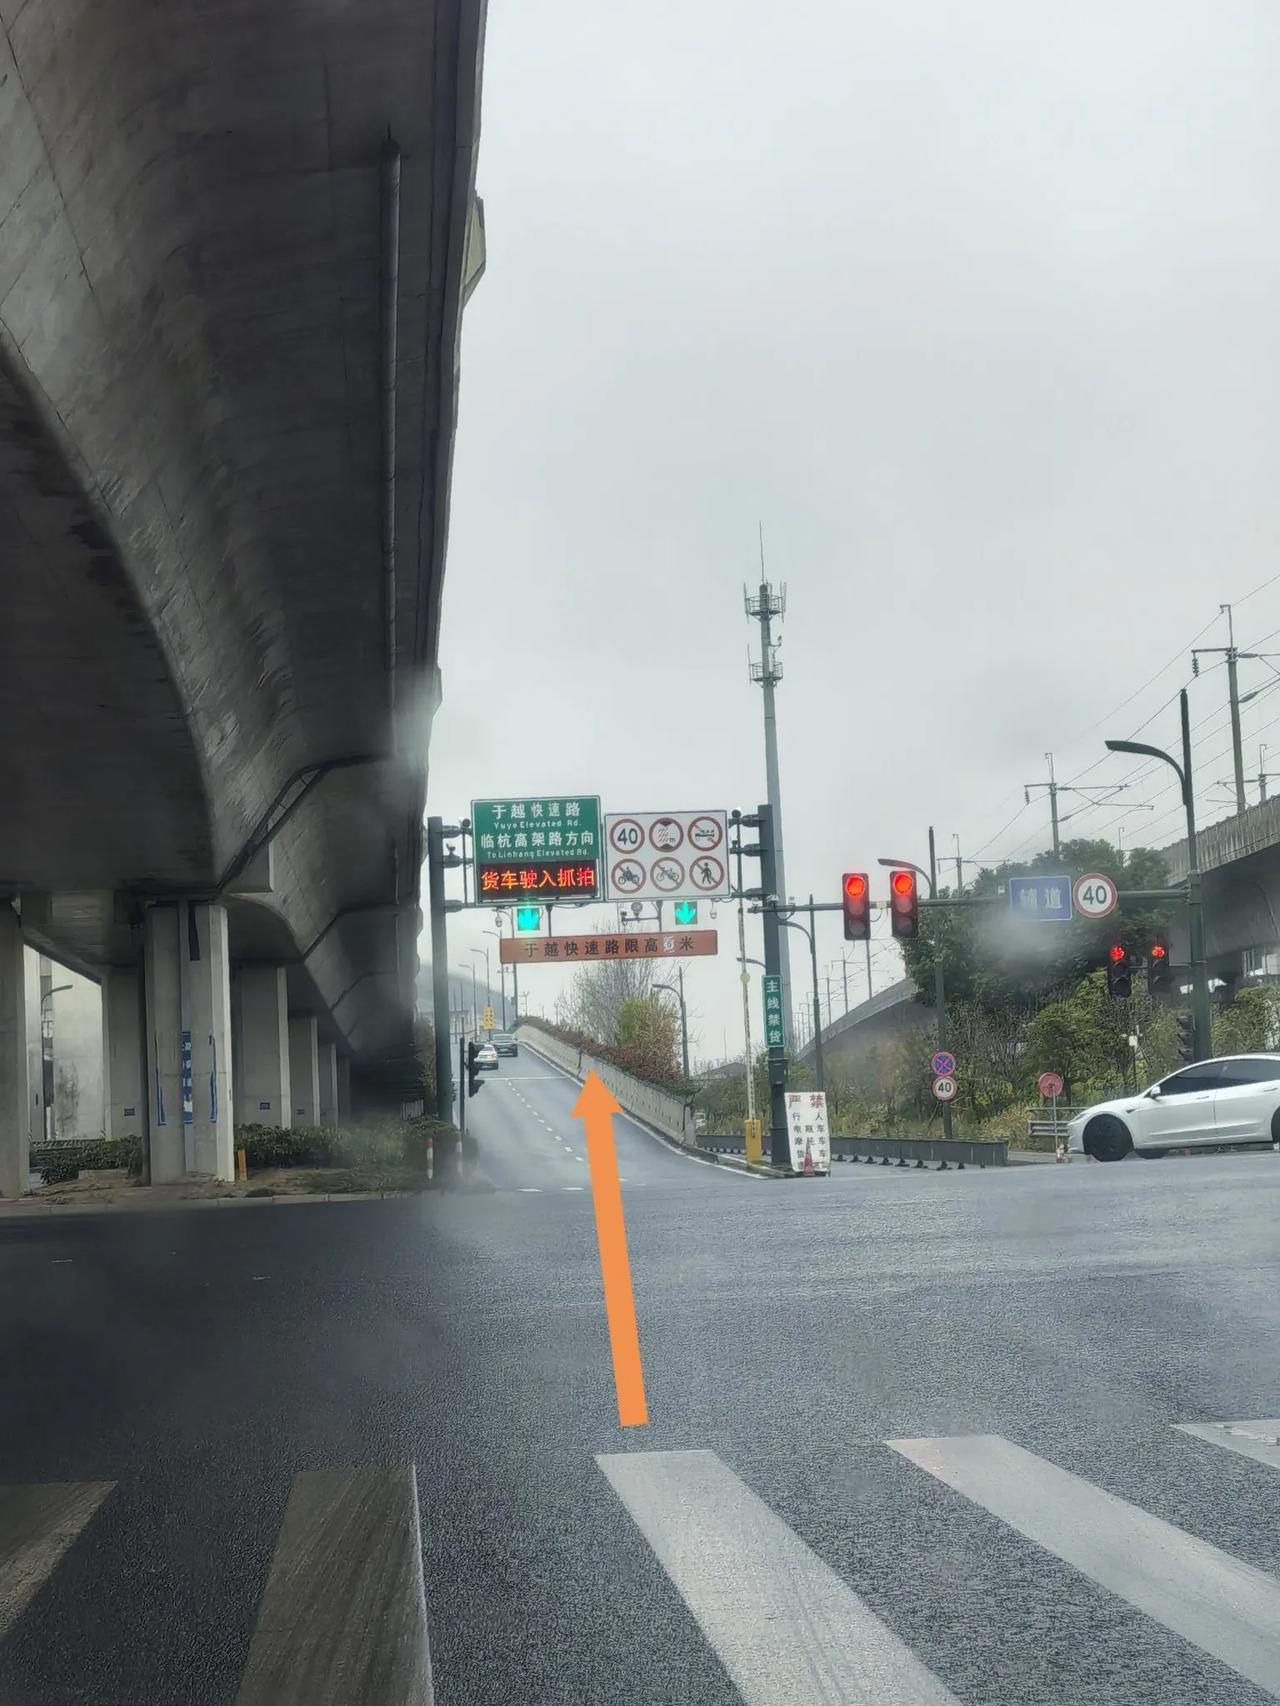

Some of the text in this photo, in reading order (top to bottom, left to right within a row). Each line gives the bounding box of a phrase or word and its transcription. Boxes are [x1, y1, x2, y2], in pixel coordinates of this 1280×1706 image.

[491, 802, 580, 819] 于越快速路
[493, 819, 582, 830] Yuye Elevated Rd.
[480, 830, 594, 848] 临杭高架路方向
[617, 827, 638, 845] 40
[498, 850, 535, 859] Linhang
[537, 848, 575, 857] Elevated
[481, 867, 595, 890] 货车驶入抓拍
[1082, 885, 1107, 905] 40
[766, 980, 781, 1043] 主线禁货
[937, 1082, 952, 1093] 40
[788, 1094, 824, 1109] 严禁
[792, 1112, 824, 1121] 行人
